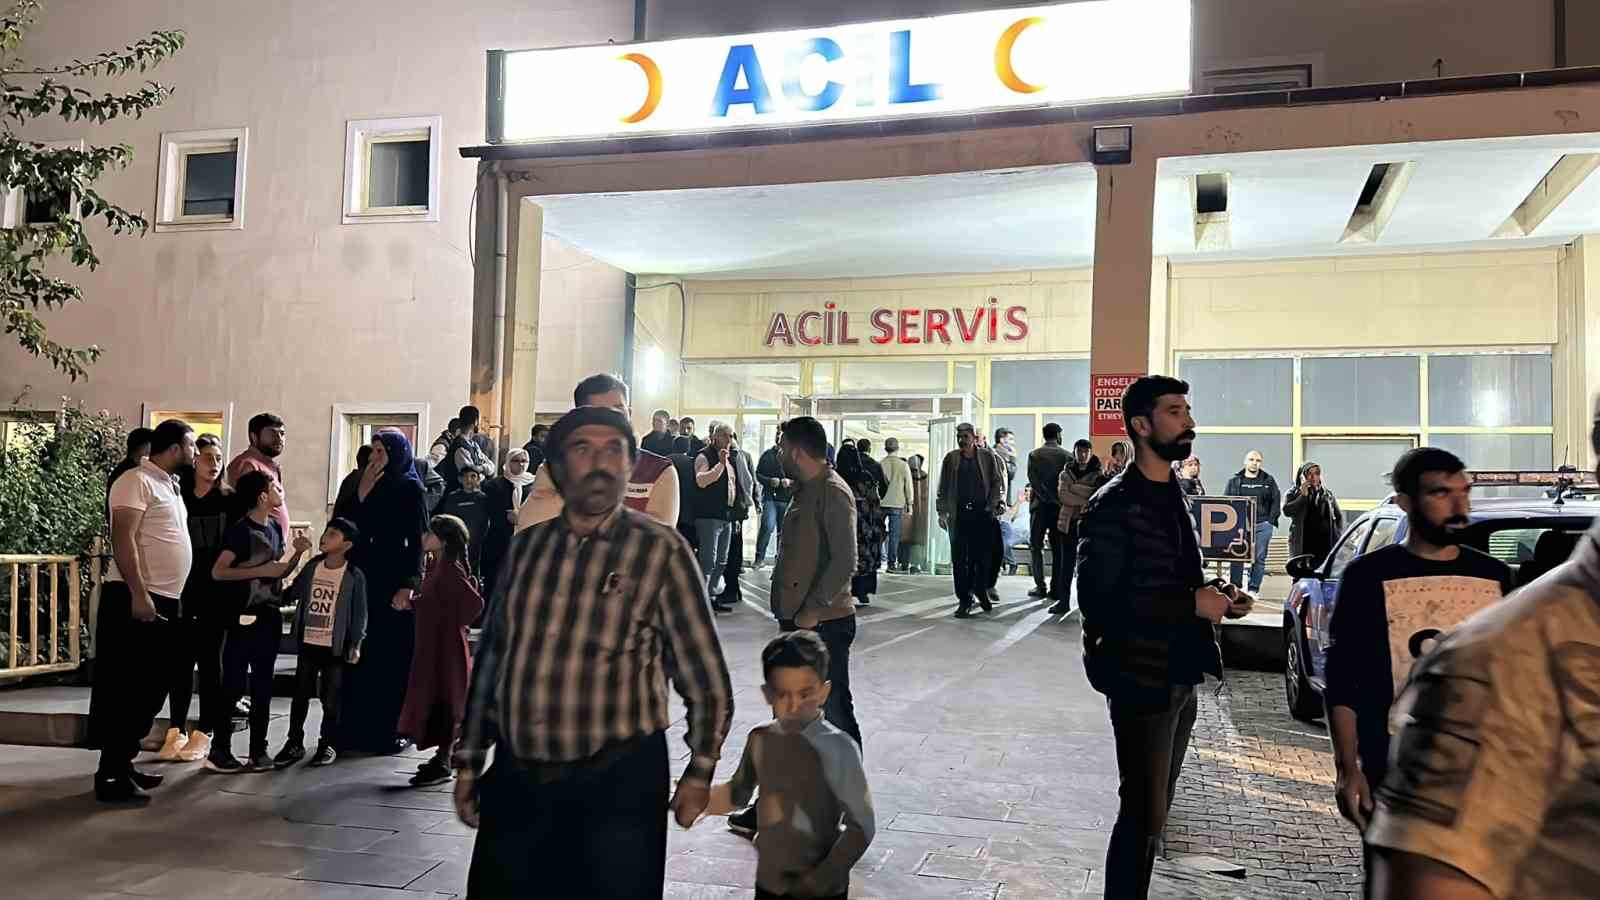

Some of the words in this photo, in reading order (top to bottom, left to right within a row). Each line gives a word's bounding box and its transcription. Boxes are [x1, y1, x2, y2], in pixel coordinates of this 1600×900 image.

[766, 302, 860, 347] ACİL
[870, 296, 1029, 345] SERVİS
[1097, 399, 1122, 409] PAR
[1201, 504, 1238, 547] P
[313, 588, 335, 600] ON
[310, 602, 331, 613] ON
